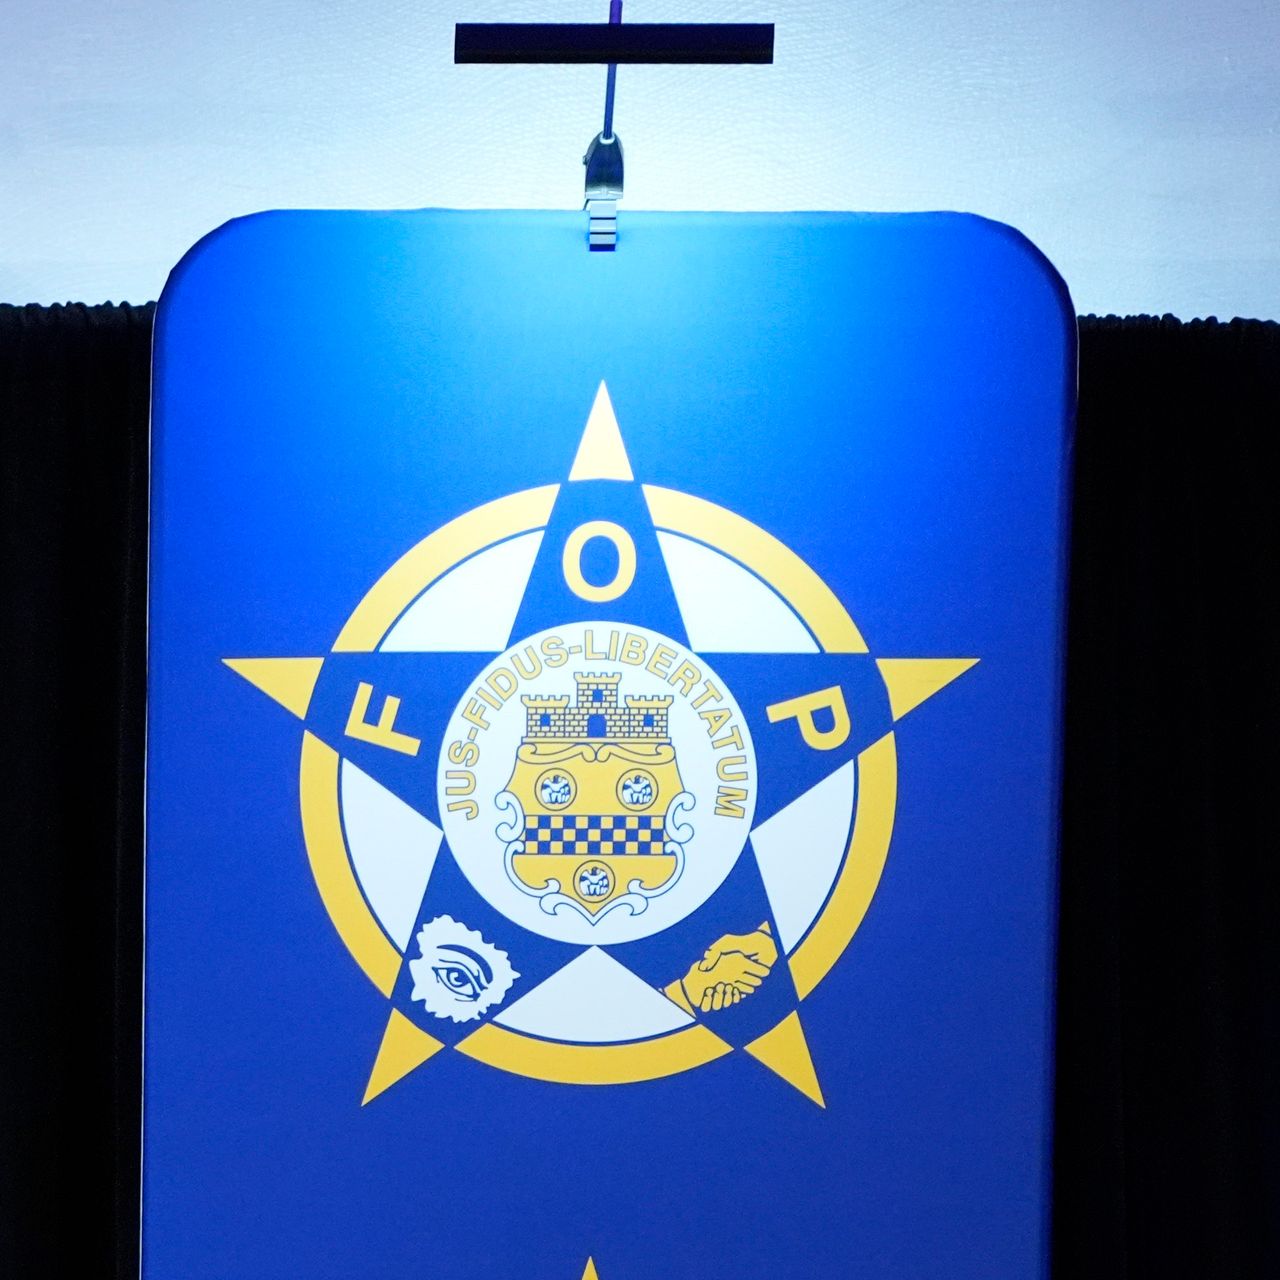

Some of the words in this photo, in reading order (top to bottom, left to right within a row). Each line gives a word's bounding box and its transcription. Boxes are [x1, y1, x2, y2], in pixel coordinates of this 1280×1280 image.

[343, 681, 423, 758] F
[562, 520, 637, 603] O
[767, 684, 853, 753] P
[446, 628, 750, 822] JUS-FIDUS-LIBERTATUM
